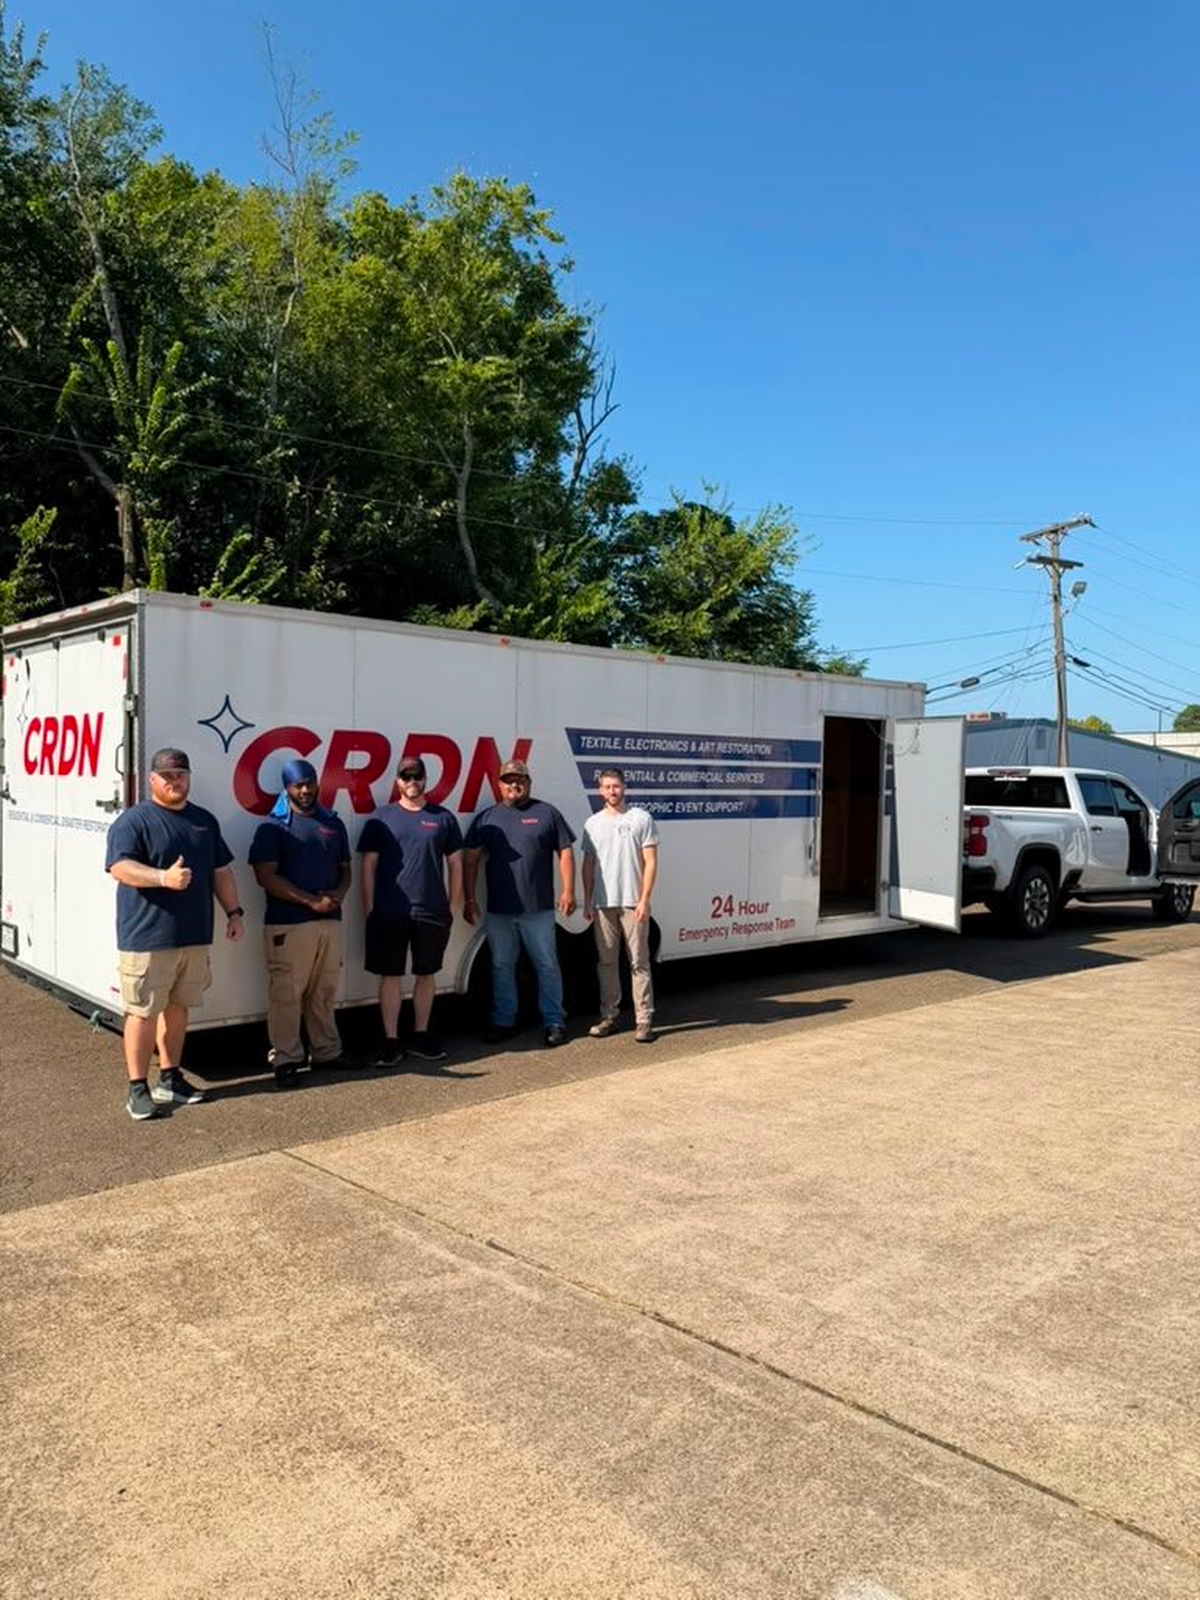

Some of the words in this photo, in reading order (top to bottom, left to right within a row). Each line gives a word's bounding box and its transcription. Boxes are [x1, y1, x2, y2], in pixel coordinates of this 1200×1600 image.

[24, 711, 104, 777] CRDN
[580, 736, 622, 750] TEXTILE,
[624, 737, 689, 752] ELECTRONICS
[690, 741, 697, 752] &
[698, 741, 716, 753] ART
[717, 742, 772, 755] RESTORATION
[233, 726, 534, 817] CRDN
[593, 769, 656, 782] RENTIAL
[658, 771, 664, 782] &
[667, 771, 724, 783] COMMERCIAL
[725, 772, 765, 784] SERVICES
[675, 801, 703, 813] EVENT
[705, 801, 744, 813] SUPPORT
[711, 894, 734, 919] 24
[738, 901, 770, 916] Hour
[679, 926, 729, 942] Emergency
[731, 920, 774, 936] Response
[775, 917, 796, 930] Team
